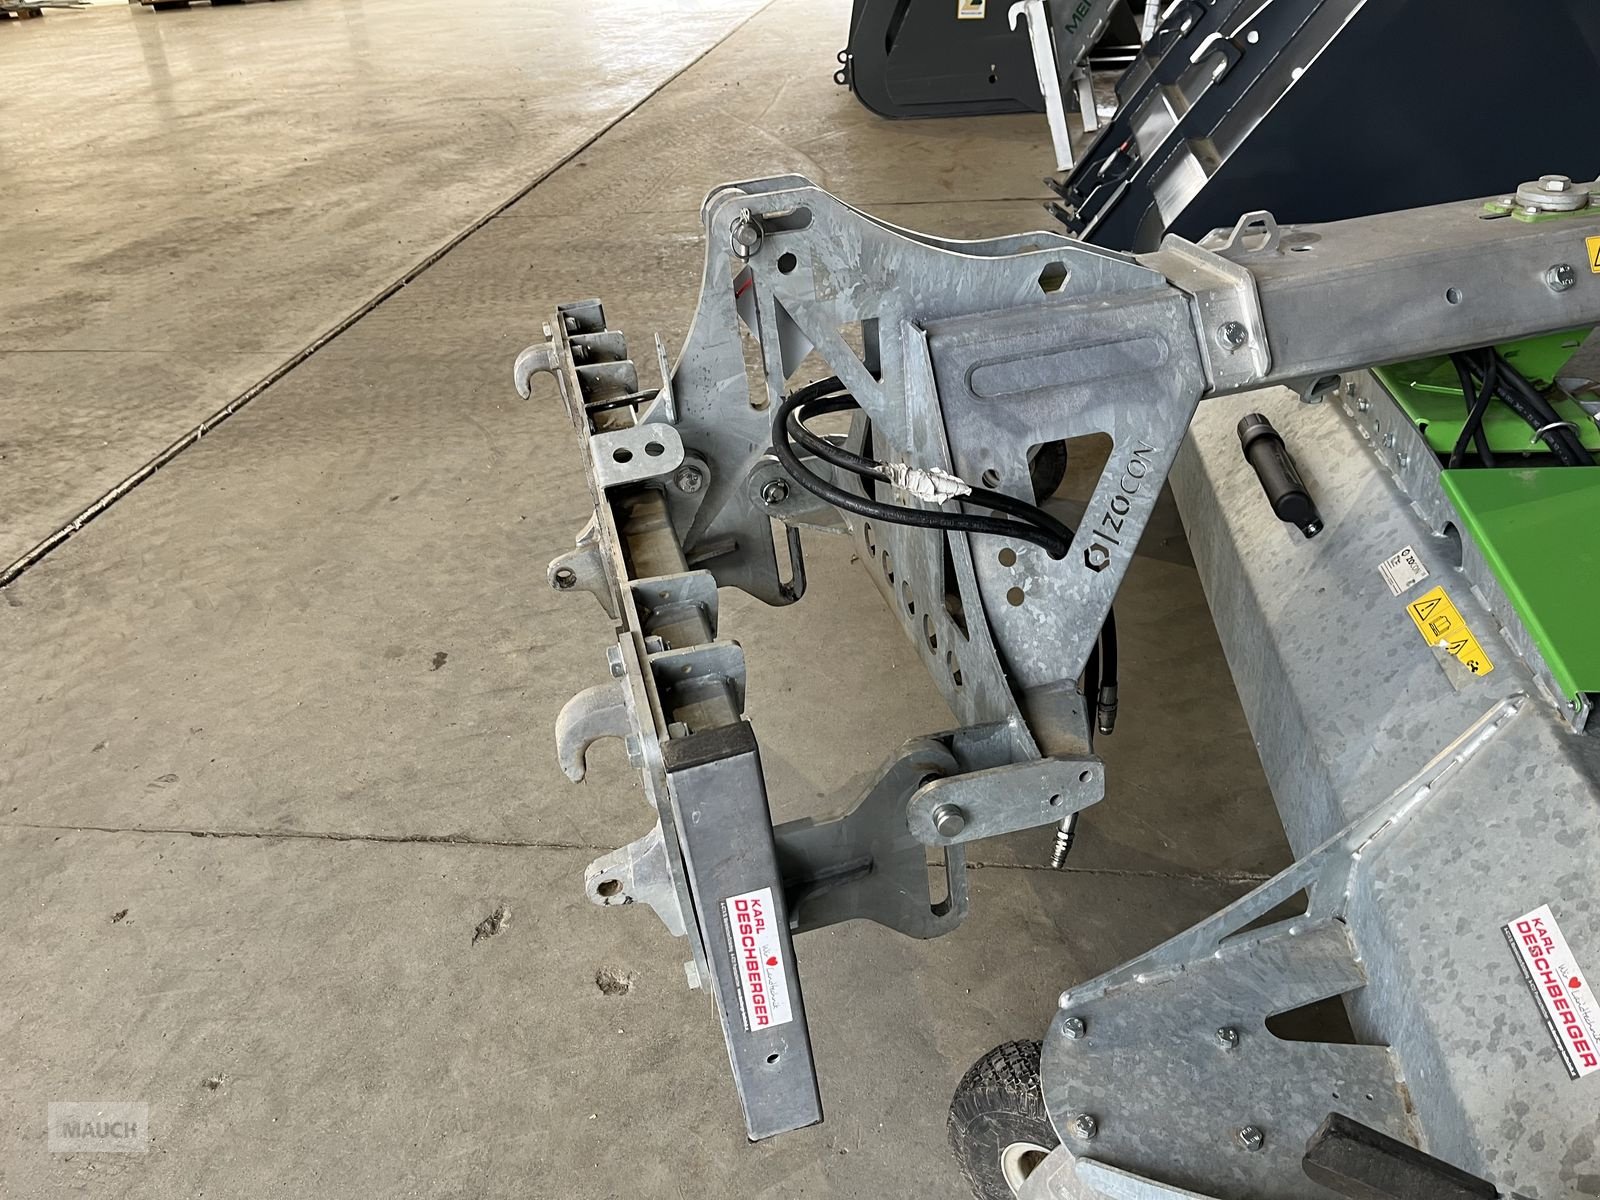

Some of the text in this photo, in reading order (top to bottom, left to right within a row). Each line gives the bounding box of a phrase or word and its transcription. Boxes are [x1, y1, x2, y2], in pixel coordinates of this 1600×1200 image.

[1102, 440, 1157, 534] ZOCON
[751, 899, 766, 935] KARL
[1532, 917, 1555, 955] KARL
[735, 899, 769, 1026] DESCHBERGER
[1516, 920, 1598, 1068] DESCHBERGER
[1558, 963, 1569, 979] Wir
